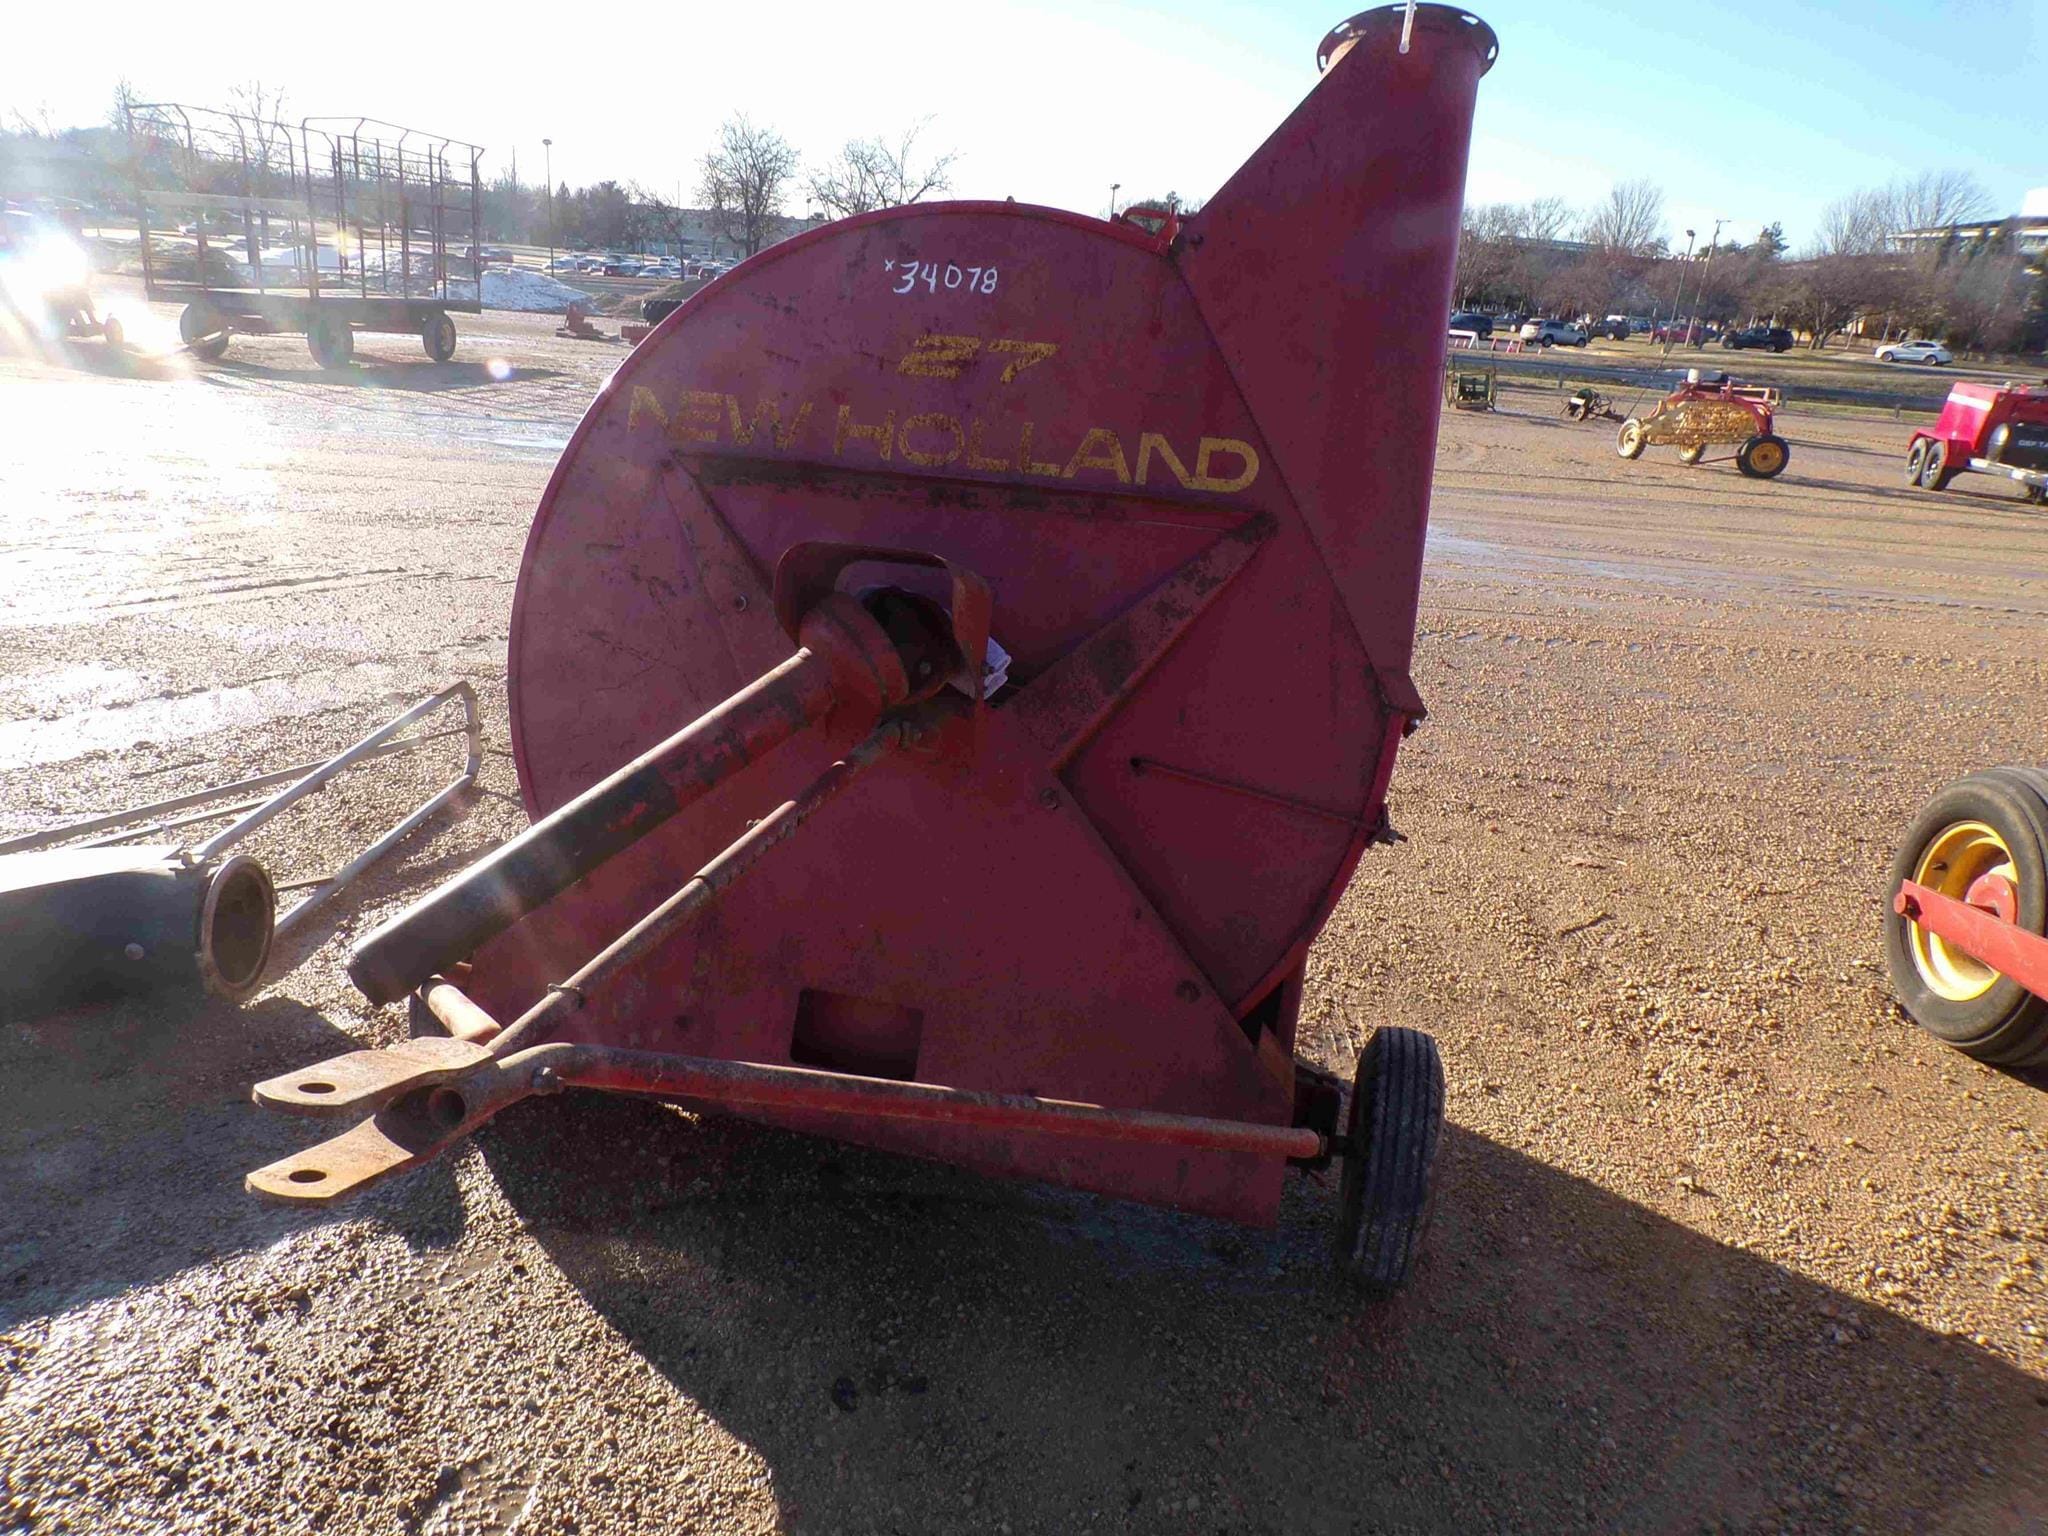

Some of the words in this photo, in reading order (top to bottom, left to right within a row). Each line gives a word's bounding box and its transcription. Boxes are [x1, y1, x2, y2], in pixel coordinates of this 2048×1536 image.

[897, 334, 1060, 384] 27
[627, 385, 814, 451] NEW
[832, 404, 1260, 494] HOLLAND
